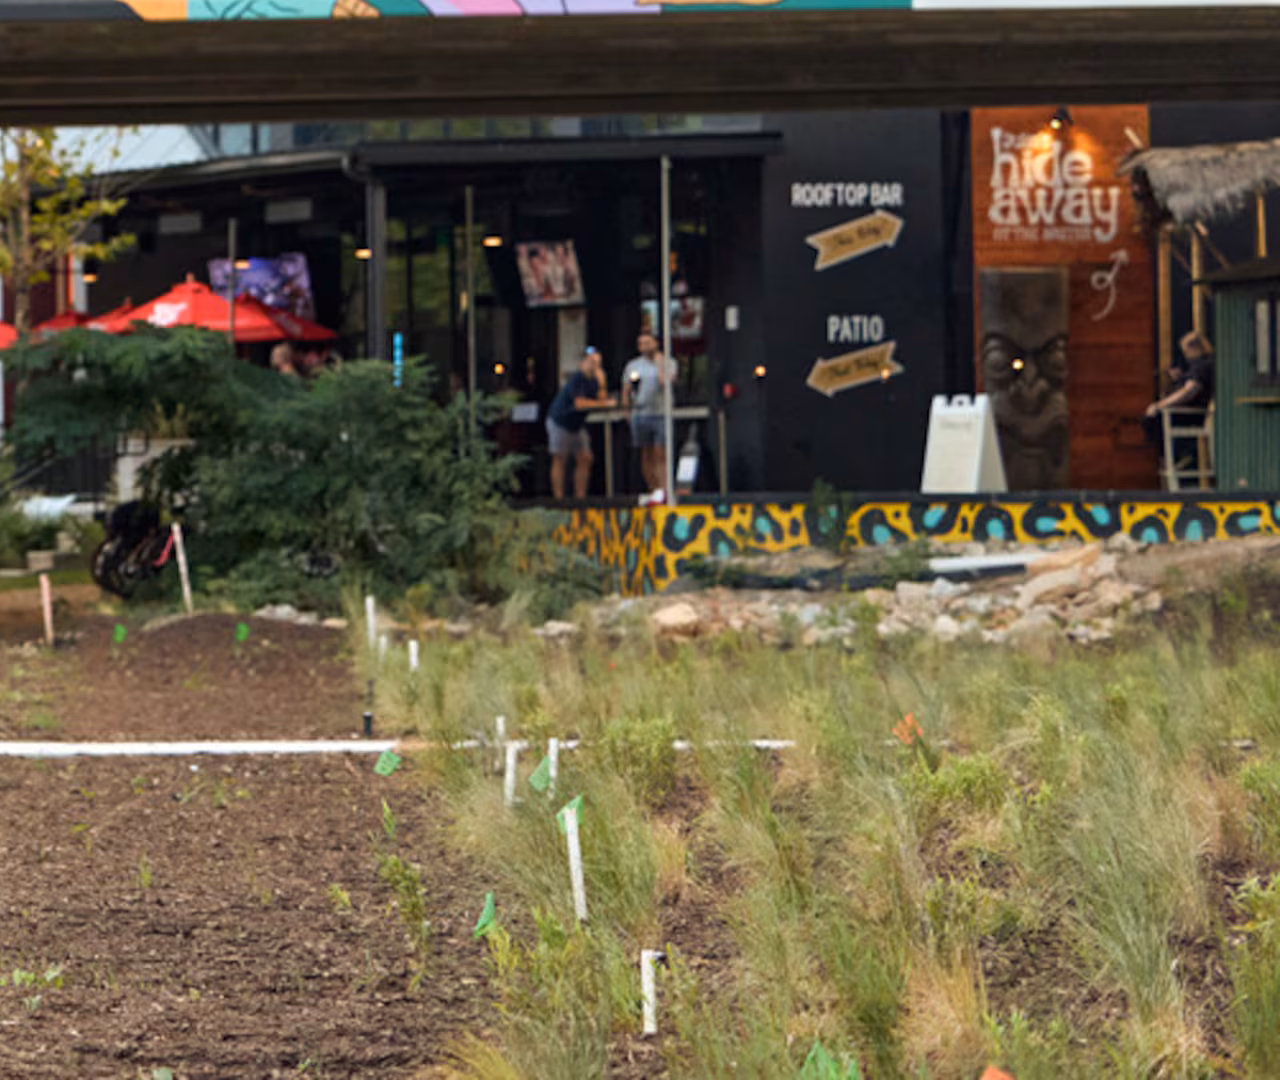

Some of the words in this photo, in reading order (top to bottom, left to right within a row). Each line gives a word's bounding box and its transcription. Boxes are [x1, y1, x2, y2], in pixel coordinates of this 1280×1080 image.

[991, 126, 1093, 188] hide
[791, 182, 869, 207] ROOFTOP
[870, 182, 905, 206] BAR
[988, 186, 1121, 244] away
[827, 315, 885, 343] PATIO
